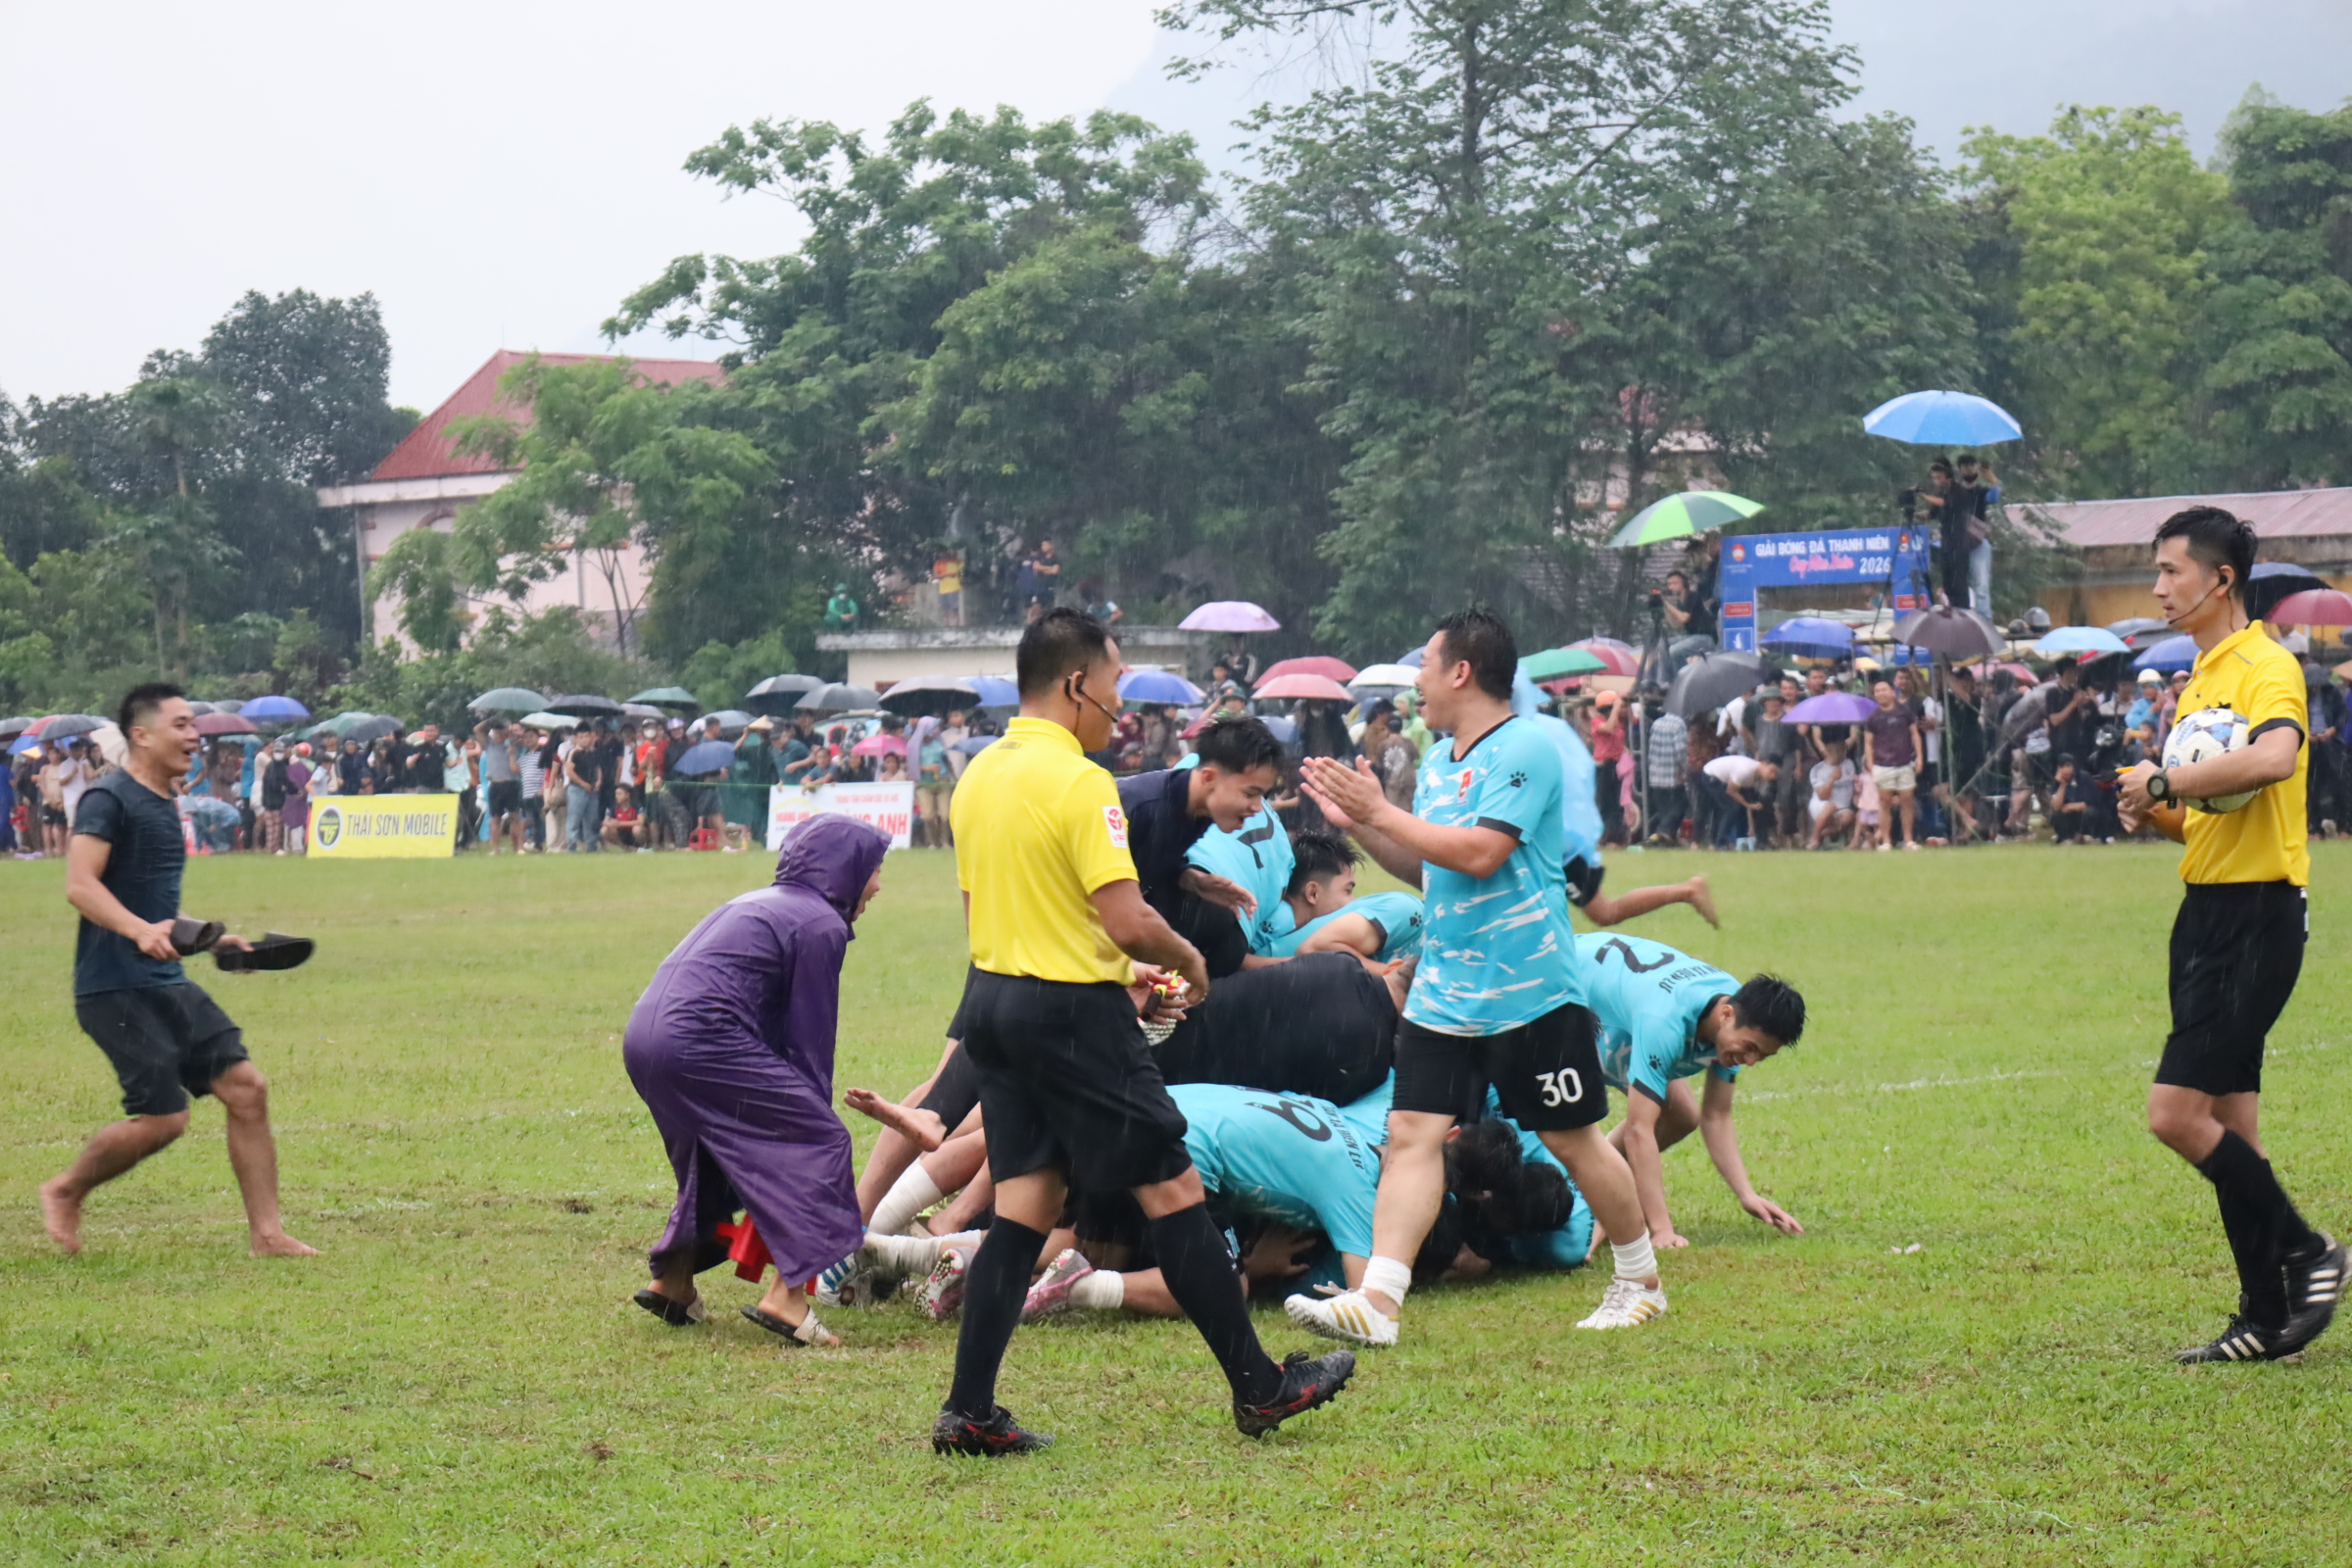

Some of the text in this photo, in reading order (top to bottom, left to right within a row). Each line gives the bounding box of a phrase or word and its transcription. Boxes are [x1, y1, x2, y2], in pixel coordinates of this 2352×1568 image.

[1755, 534, 1890, 557] GIẢI BÓNG ĐÁ THANH NIÊN
[1859, 557, 1891, 574] 2026
[347, 808, 448, 836] THÁI SƠN MOBILE
[877, 812, 908, 835] ANH
[1594, 937, 1676, 973] 2
[1535, 1067, 1584, 1107] 30
